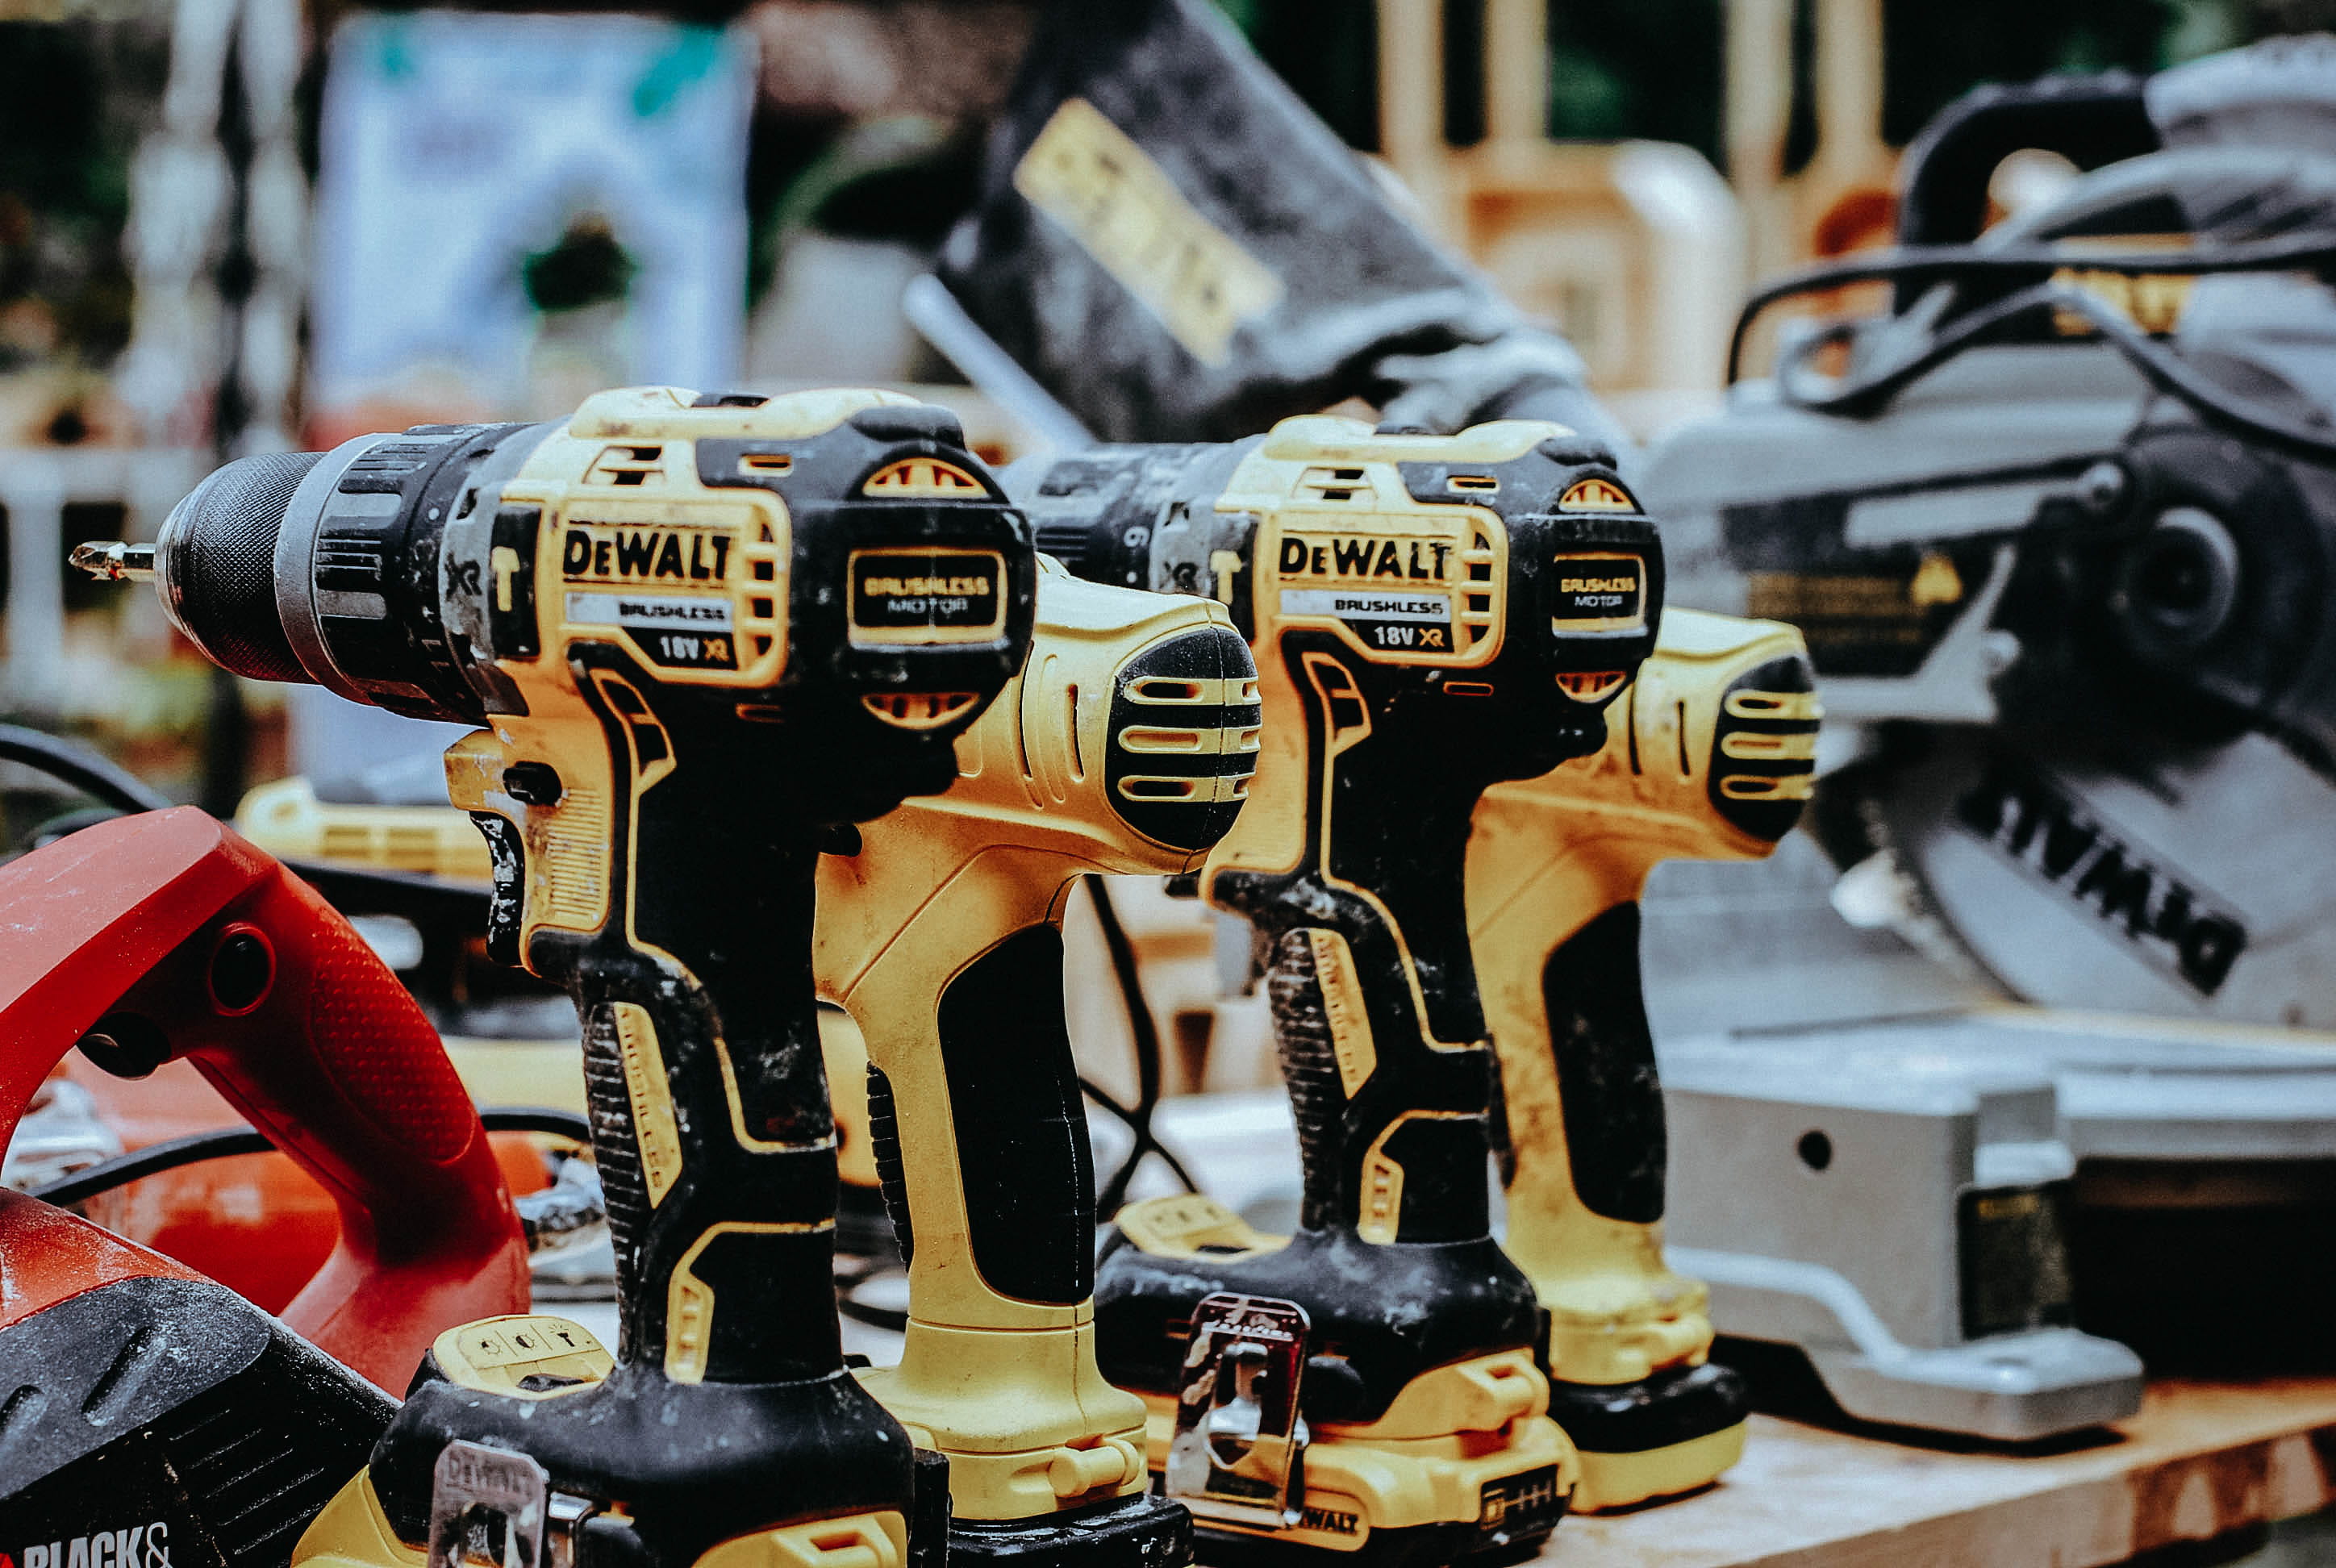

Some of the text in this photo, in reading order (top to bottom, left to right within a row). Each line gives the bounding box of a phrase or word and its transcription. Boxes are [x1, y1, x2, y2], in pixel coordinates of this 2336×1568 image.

[562, 529, 730, 580] DEWALT
[1279, 537, 1451, 580] DEWALT
[1334, 598, 1443, 615] BRUSHLESS
[1374, 626, 1445, 647] 18V XR
